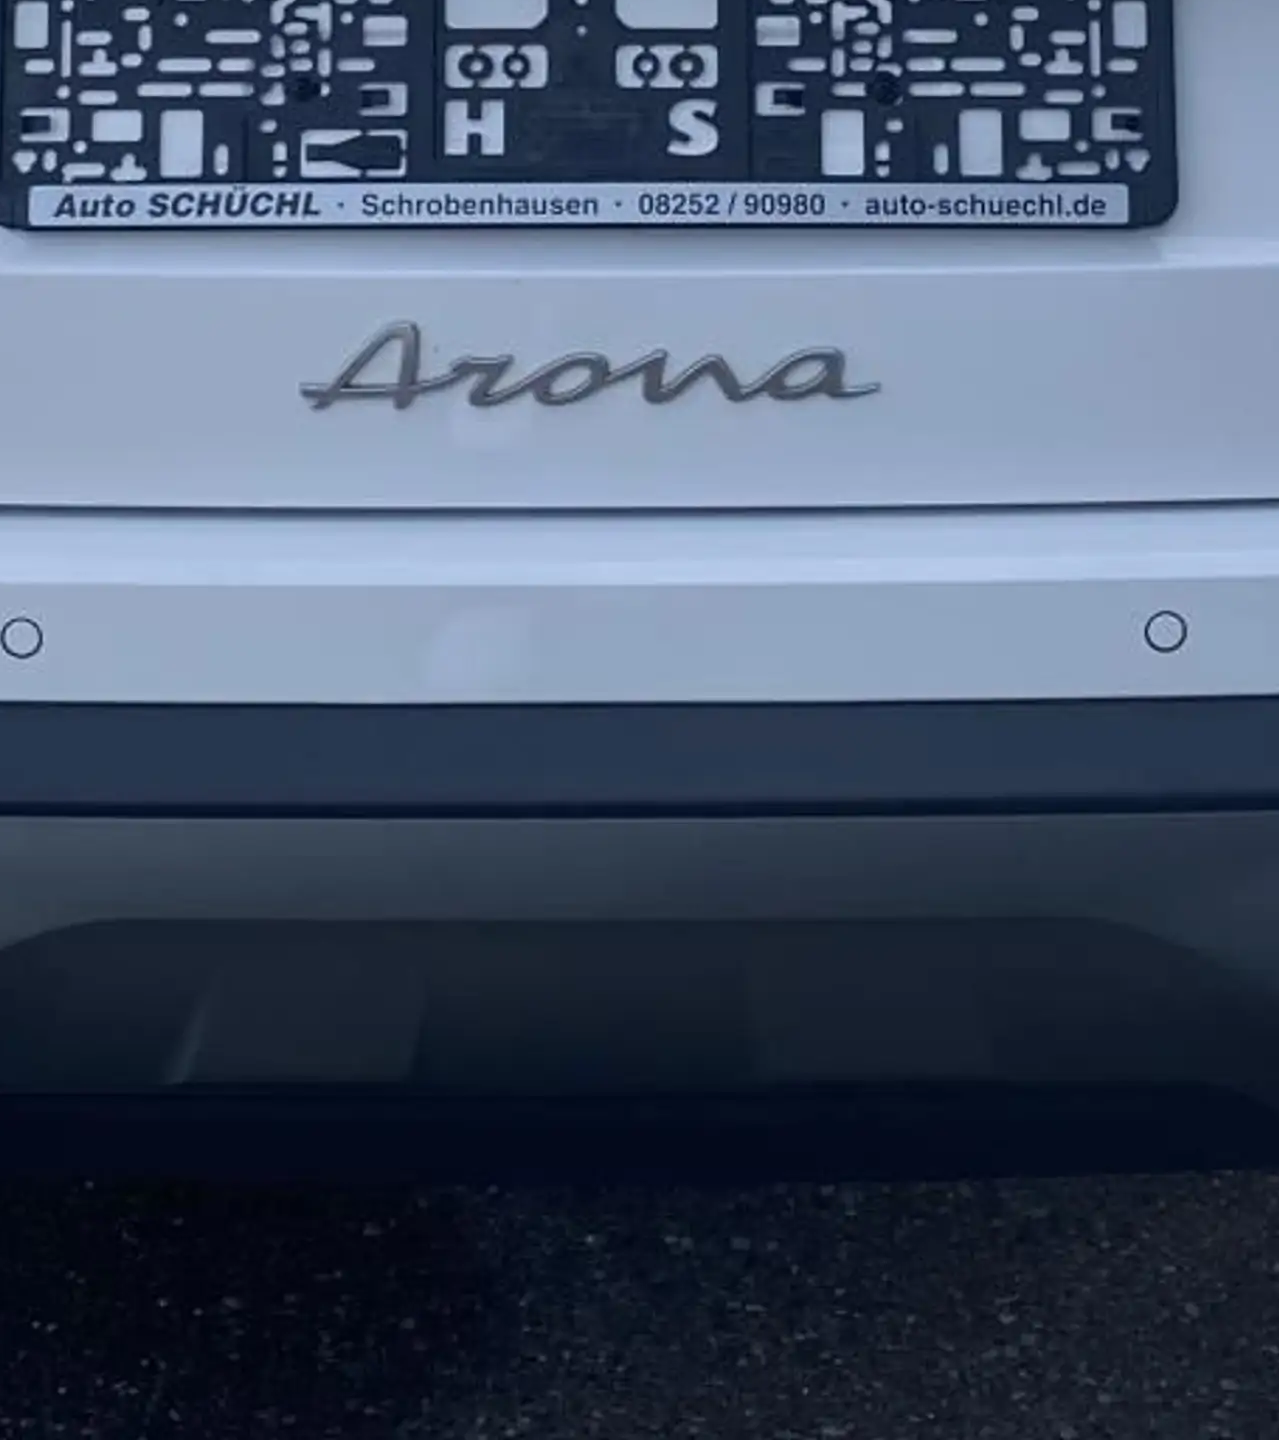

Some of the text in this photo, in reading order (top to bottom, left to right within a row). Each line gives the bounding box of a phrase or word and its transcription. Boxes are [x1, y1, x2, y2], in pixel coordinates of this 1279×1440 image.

[53, 192, 136, 218] Auto
[146, 185, 322, 218] SCHÜCHL
[361, 192, 599, 217] Schrobenhausen
[638, 192, 721, 216] 08252
[743, 192, 826, 216] 90980
[865, 193, 1107, 217] auto-schuechl.de
[299, 319, 881, 410] Arona
